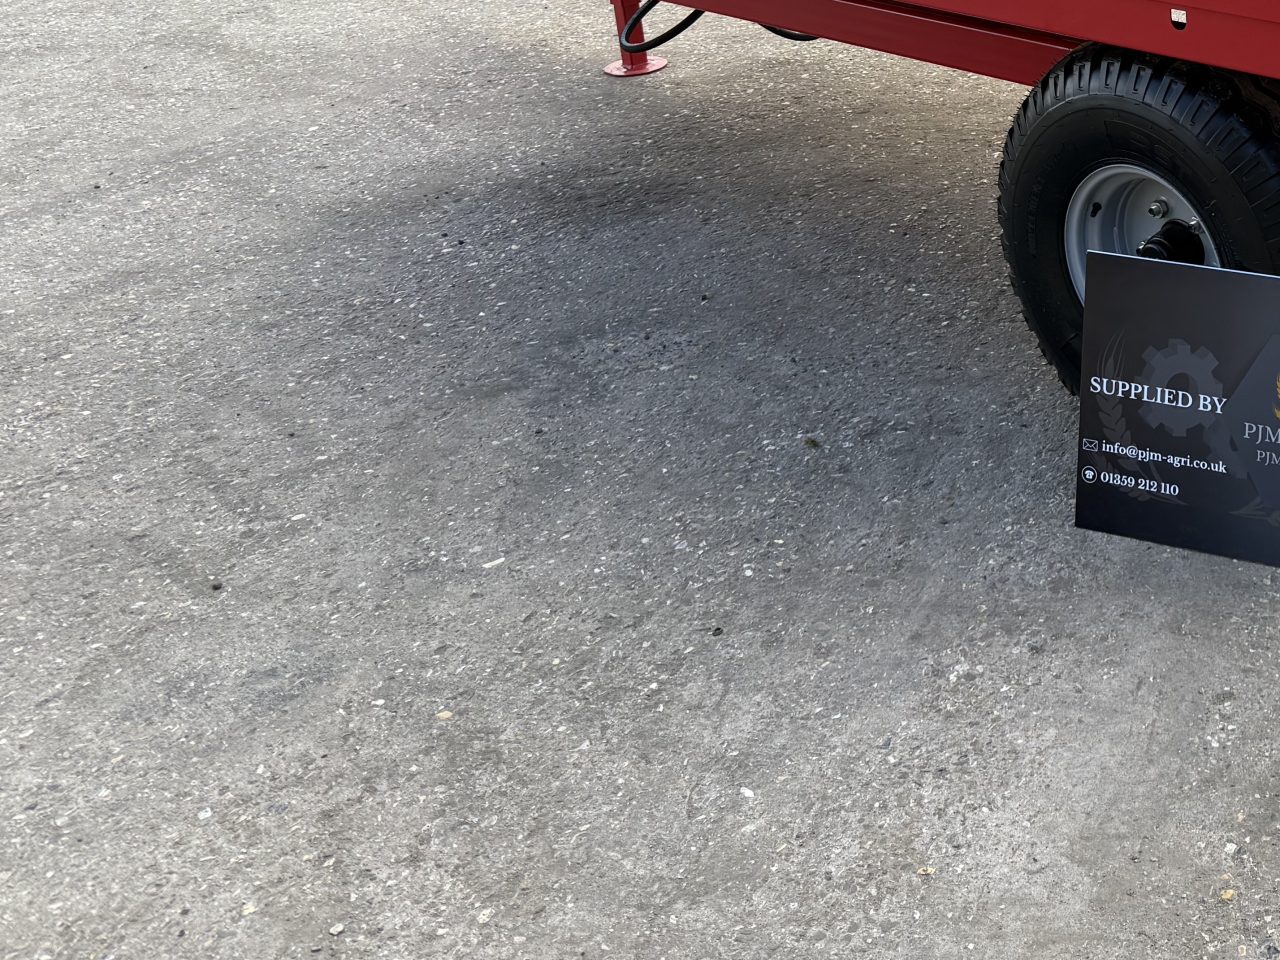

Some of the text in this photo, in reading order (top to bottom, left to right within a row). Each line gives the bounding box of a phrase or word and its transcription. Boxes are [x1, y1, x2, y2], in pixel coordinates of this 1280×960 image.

[1089, 376, 1228, 414] SUPPLIED BY
[1101, 439, 1227, 474] info@pjm-agri.co.uk
[1100, 471, 1180, 496] 01359 212 110
